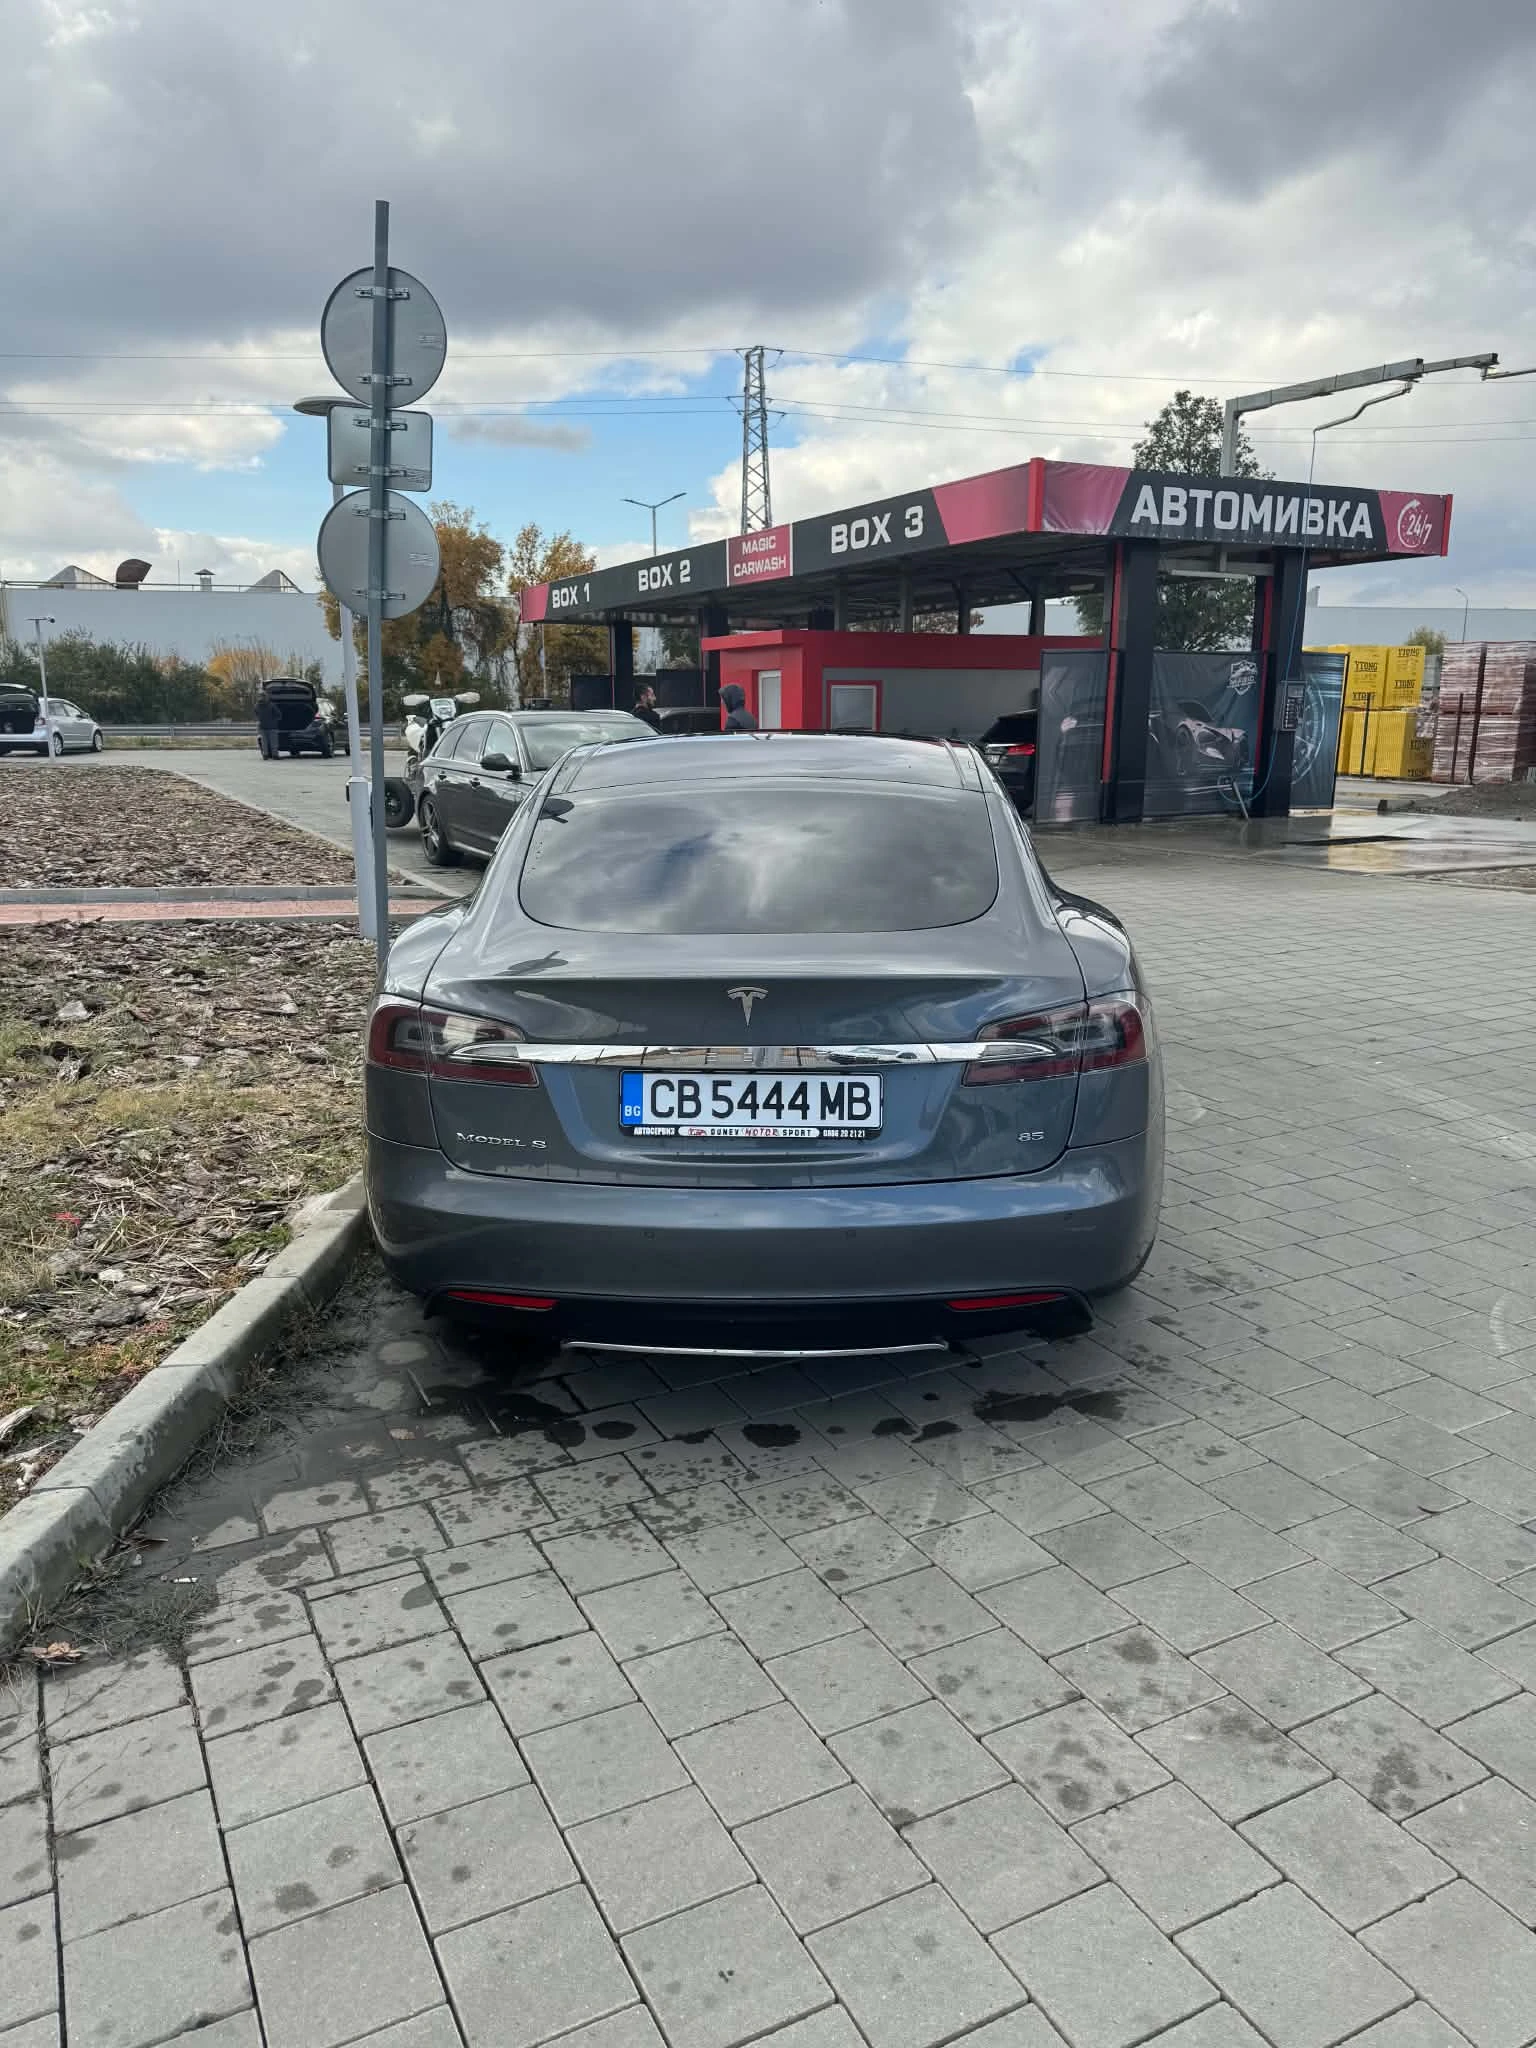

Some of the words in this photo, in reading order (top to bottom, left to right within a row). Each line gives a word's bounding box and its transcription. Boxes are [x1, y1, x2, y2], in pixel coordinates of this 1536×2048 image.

[1130, 484, 1373, 538] АВТОМИВКА
[831, 512, 892, 554] BOX
[904, 505, 924, 539] 3
[1406, 512, 1433, 545] 24/7
[742, 536, 777, 555] MAGIC
[638, 562, 673, 592] BOX
[680, 559, 691, 583] 2
[733, 556, 787, 577] CARWASH
[552, 585, 578, 608] BOX
[583, 582, 590, 602] 1
[1354, 660, 1378, 672] YTONG
[650, 1079, 701, 1119] CB
[711, 1080, 809, 1120] 5444
[819, 1081, 872, 1121] MB
[624, 1105, 641, 1117] BG
[456, 1132, 527, 1147] MODEL
[532, 1140, 547, 1149] S
[744, 1128, 778, 1137] MOTOR
[782, 1129, 812, 1137] SPORT
[1018, 1131, 1045, 1142] 85
